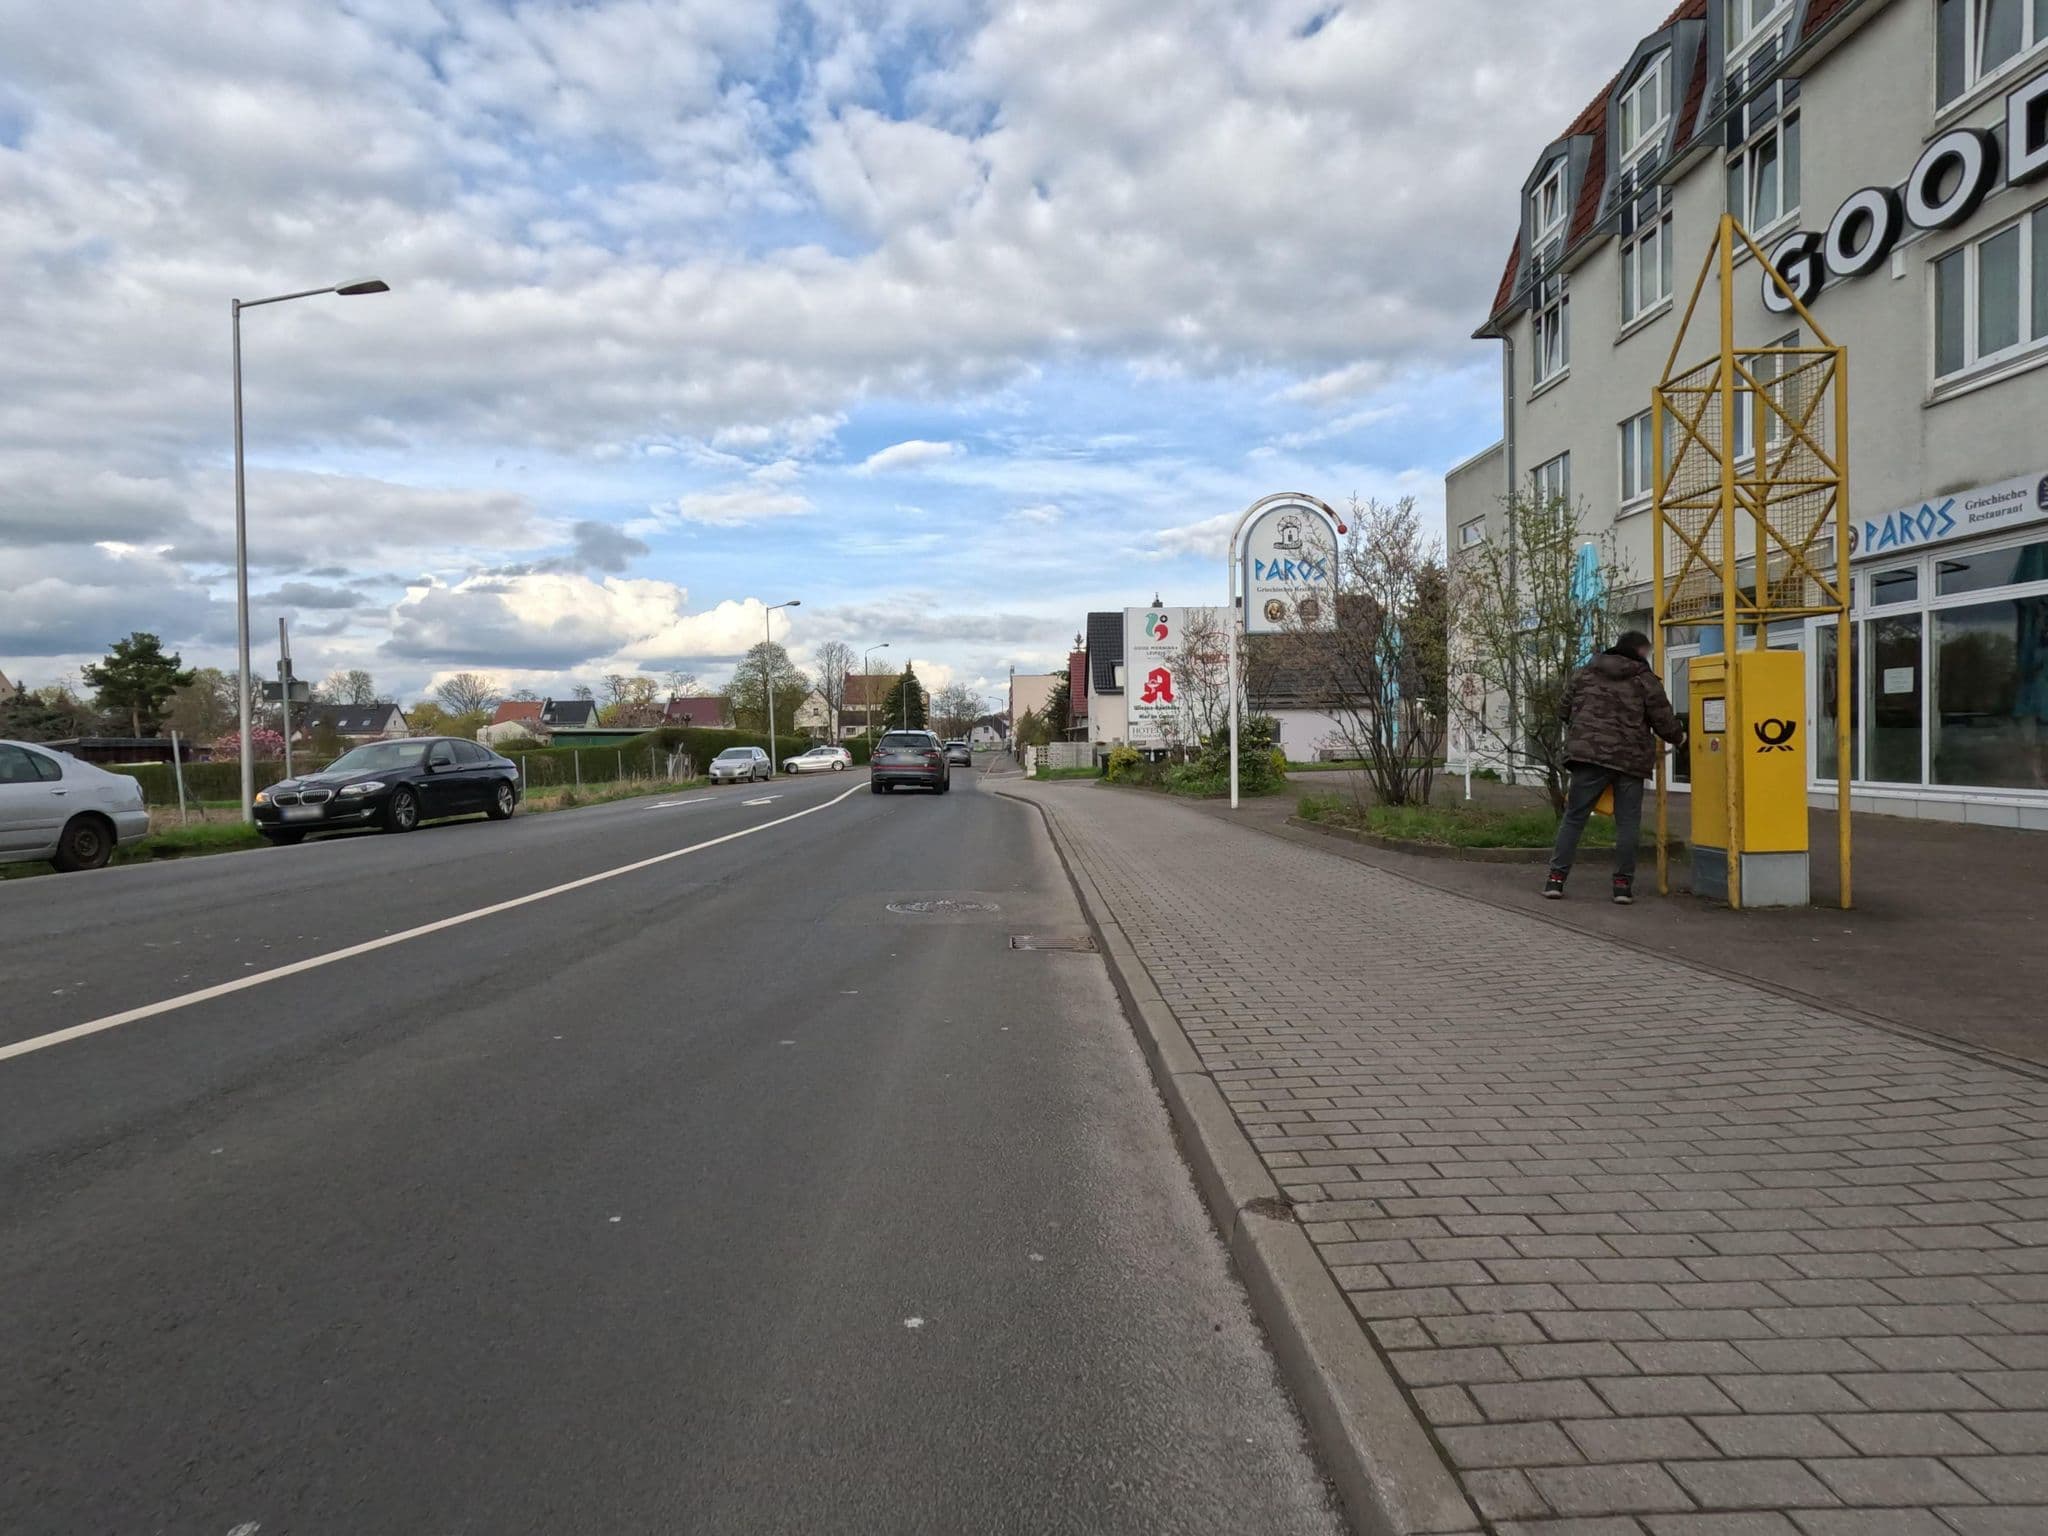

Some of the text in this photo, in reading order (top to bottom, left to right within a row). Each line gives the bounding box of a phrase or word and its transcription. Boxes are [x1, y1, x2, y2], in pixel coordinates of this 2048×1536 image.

[1965, 489, 2028, 510] Griechisches
[1968, 503, 2023, 523] Restaurant
[1865, 498, 1956, 552] PAROS
[1255, 557, 1327, 580] PAROS
